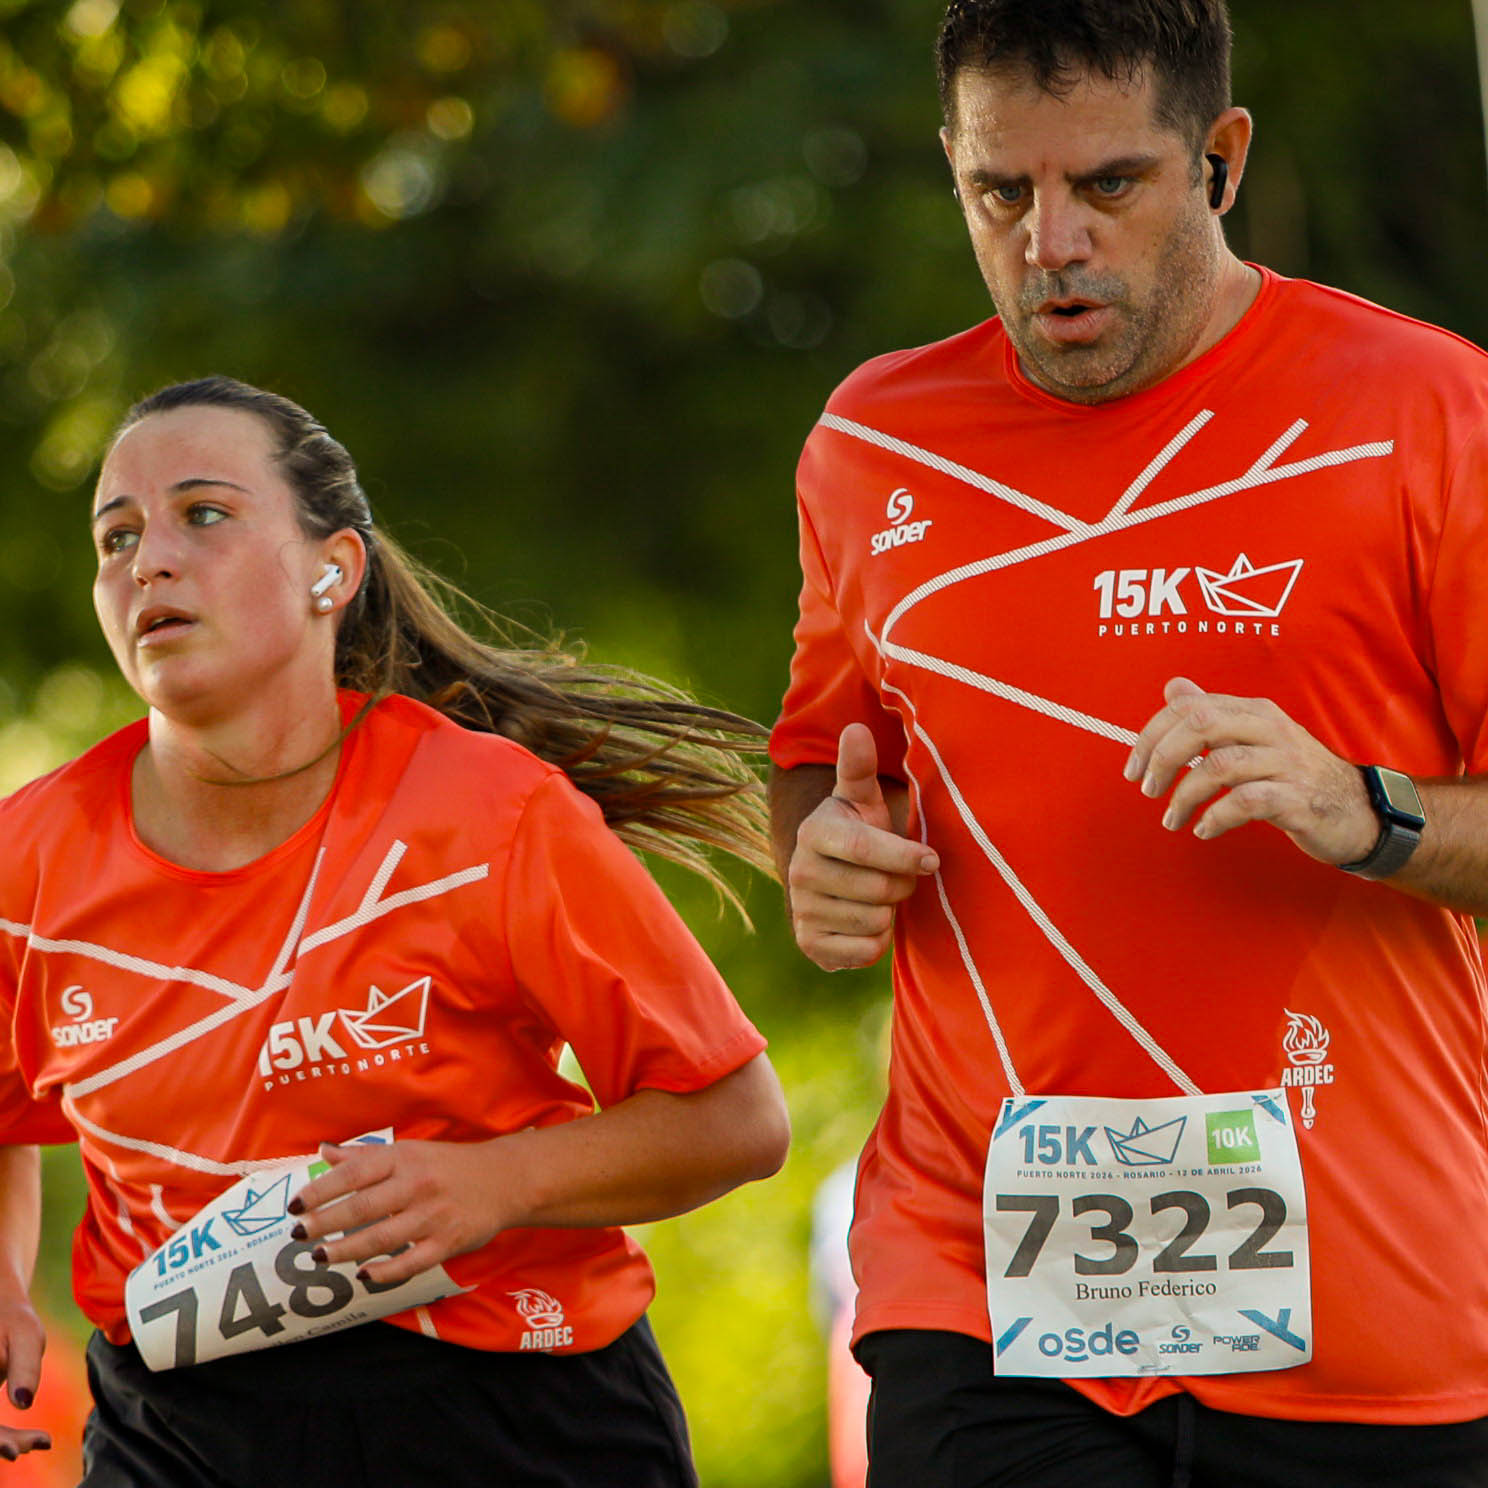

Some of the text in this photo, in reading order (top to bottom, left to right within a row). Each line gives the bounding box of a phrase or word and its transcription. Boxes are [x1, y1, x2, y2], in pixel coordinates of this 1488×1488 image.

[1093, 567, 1192, 619] 15K
[1098, 621, 1281, 637] PUERTO NORTE
[357, 1043, 431, 1072] NORTE
[1280, 1064, 1334, 1087] ARDEC
[1019, 1124, 1099, 1166] 15K
[1211, 1126, 1253, 1150] 10K
[1016, 1169, 1053, 1179] PUERTO
[1056, 1170, 1087, 1180] NORTE
[1090, 1171, 1113, 1180] 2026
[1123, 1170, 1166, 1180] ROSARIO
[1191, 1167, 1203, 1177] DE
[1207, 1166, 1235, 1176] ABRIL
[1239, 1164, 1263, 1174] 2026
[996, 1186, 1294, 1279] 7322
[153, 1216, 223, 1277] 15K
[1075, 1279, 1217, 1301] Bruno Federico
[519, 1326, 574, 1350] ARDEC
[1038, 1321, 1141, 1361] osde
[1213, 1335, 1260, 1345] POWER
